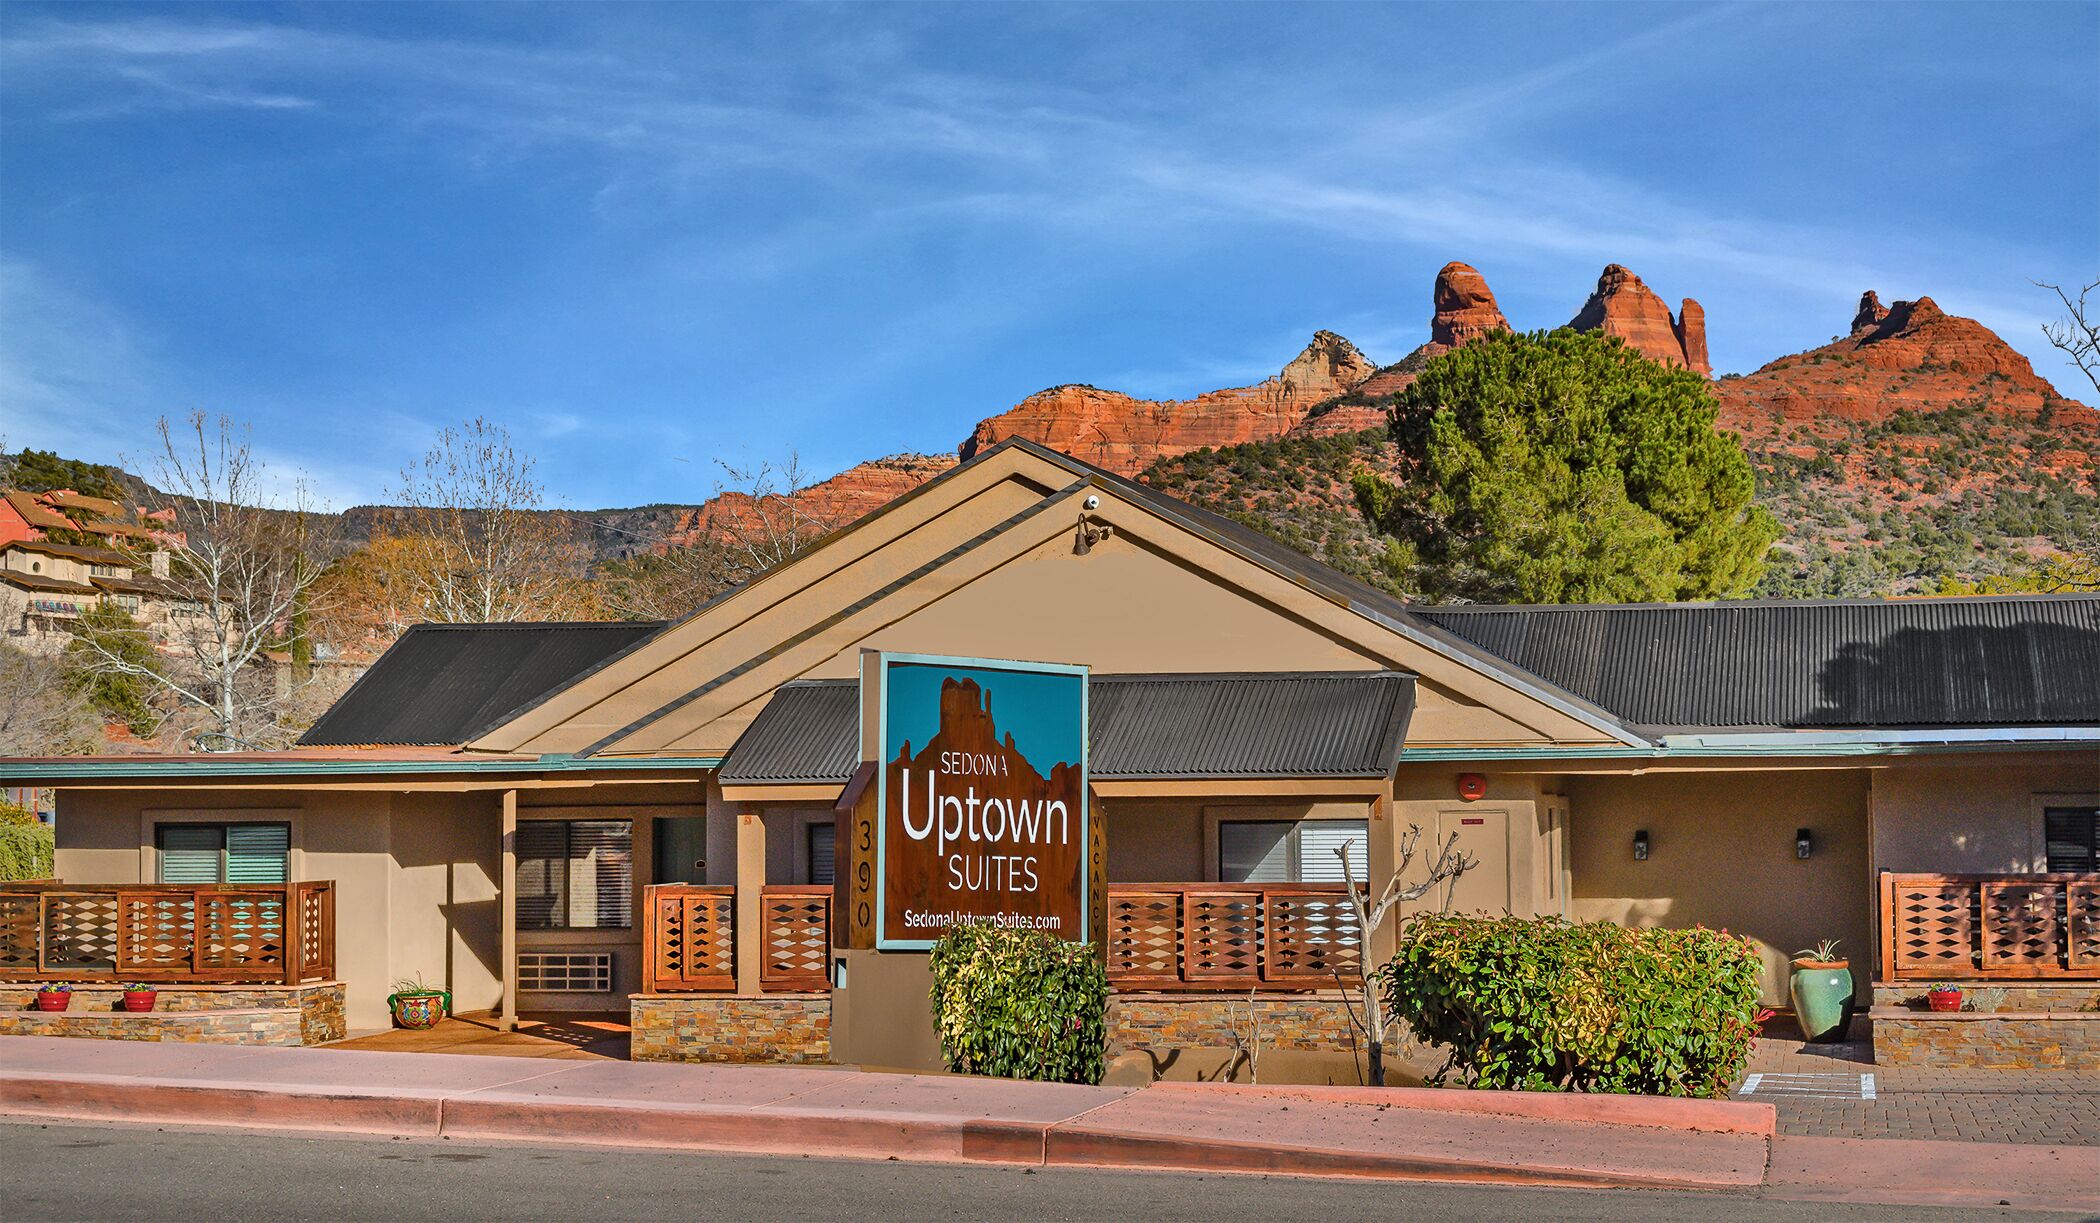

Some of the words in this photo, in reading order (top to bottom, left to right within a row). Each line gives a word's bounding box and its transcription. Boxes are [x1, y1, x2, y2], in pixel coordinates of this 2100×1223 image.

[941, 751, 1008, 777] SEDONA
[902, 768, 1068, 857] Uptown
[857, 820, 871, 928] 390
[948, 854, 1038, 892] SUITES
